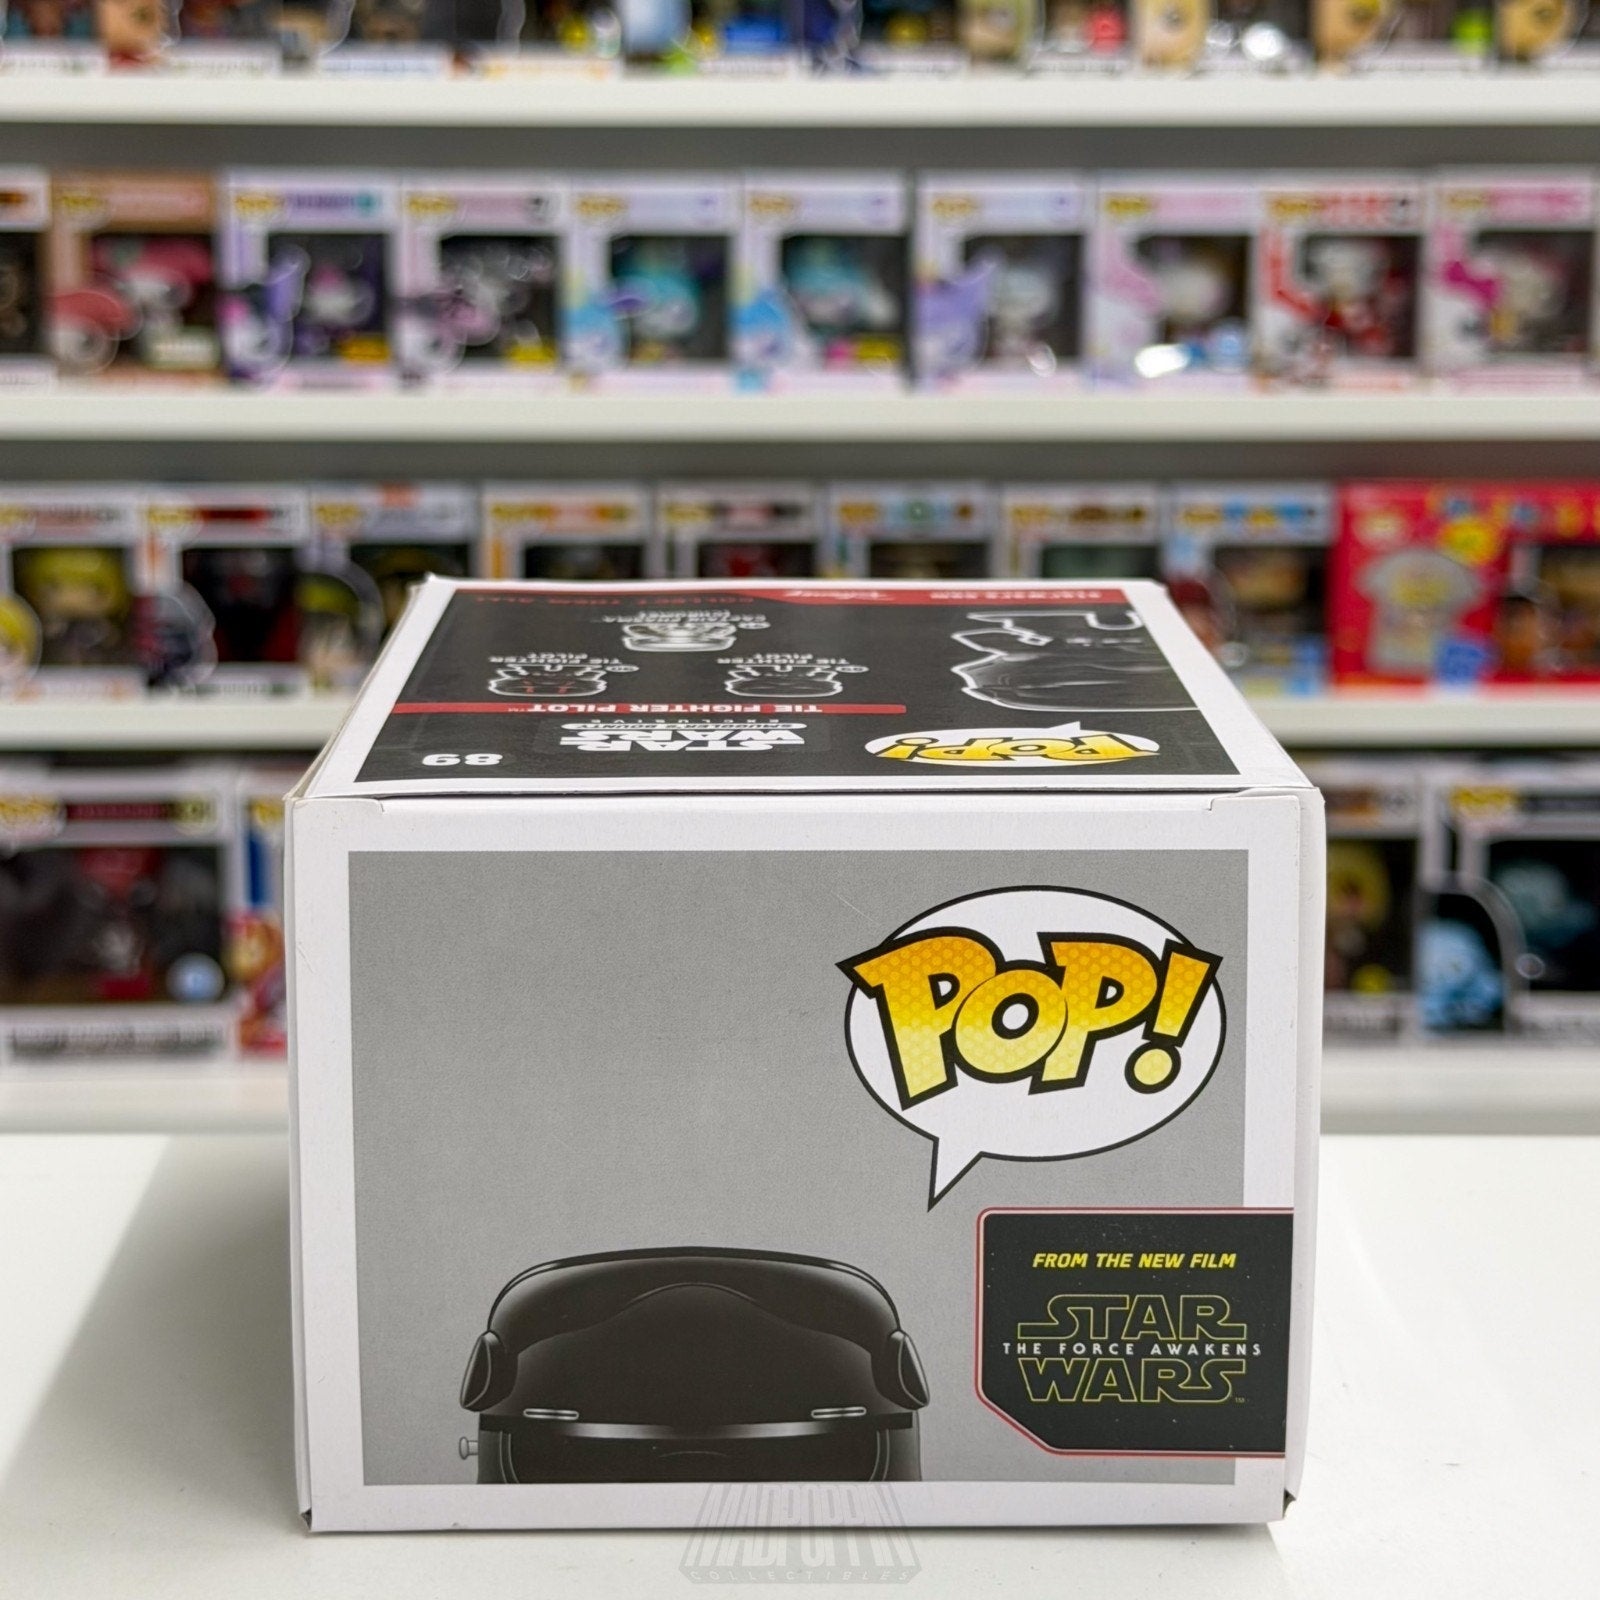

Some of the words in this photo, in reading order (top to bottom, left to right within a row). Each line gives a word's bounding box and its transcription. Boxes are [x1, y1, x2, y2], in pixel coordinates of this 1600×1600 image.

[629, 704, 762, 713] FIGHTER
[774, 704, 823, 713] TIE
[560, 730, 804, 741] WARS
[560, 740, 804, 752] STAR
[422, 753, 503, 766] 89
[836, 927, 1223, 1111] POP!
[1032, 1253, 1089, 1268] FROM
[1096, 1253, 1134, 1268] THE
[1138, 1253, 1186, 1268] NEW
[1190, 1253, 1237, 1268] FILM
[1017, 1294, 1248, 1341] STAR
[1002, 1342, 1041, 1356] THE
[1059, 1342, 1135, 1356] FORCE
[1150, 1342, 1262, 1356] AWAKENS
[1017, 1357, 1247, 1403] WARS
